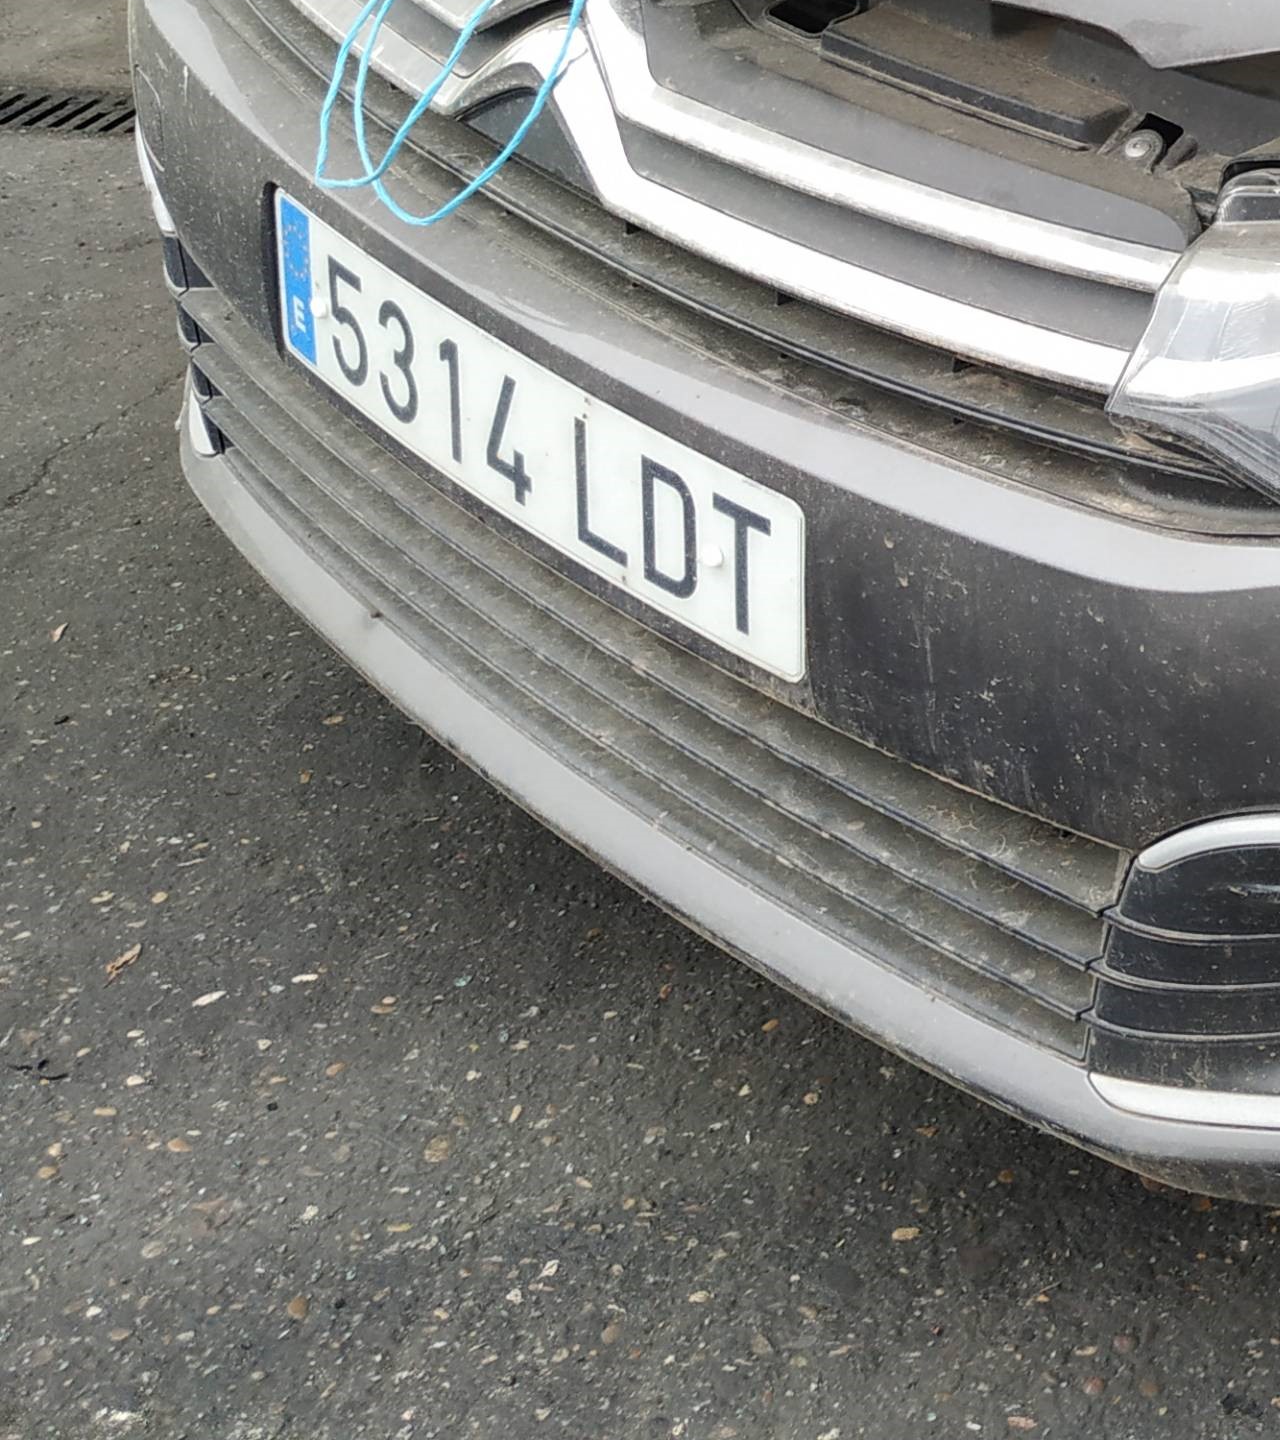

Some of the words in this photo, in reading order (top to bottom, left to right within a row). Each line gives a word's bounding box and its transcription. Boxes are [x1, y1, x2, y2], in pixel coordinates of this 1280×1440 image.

[293, 295, 306, 334] E
[327, 254, 533, 506] 5314
[574, 415, 772, 636] LDT
